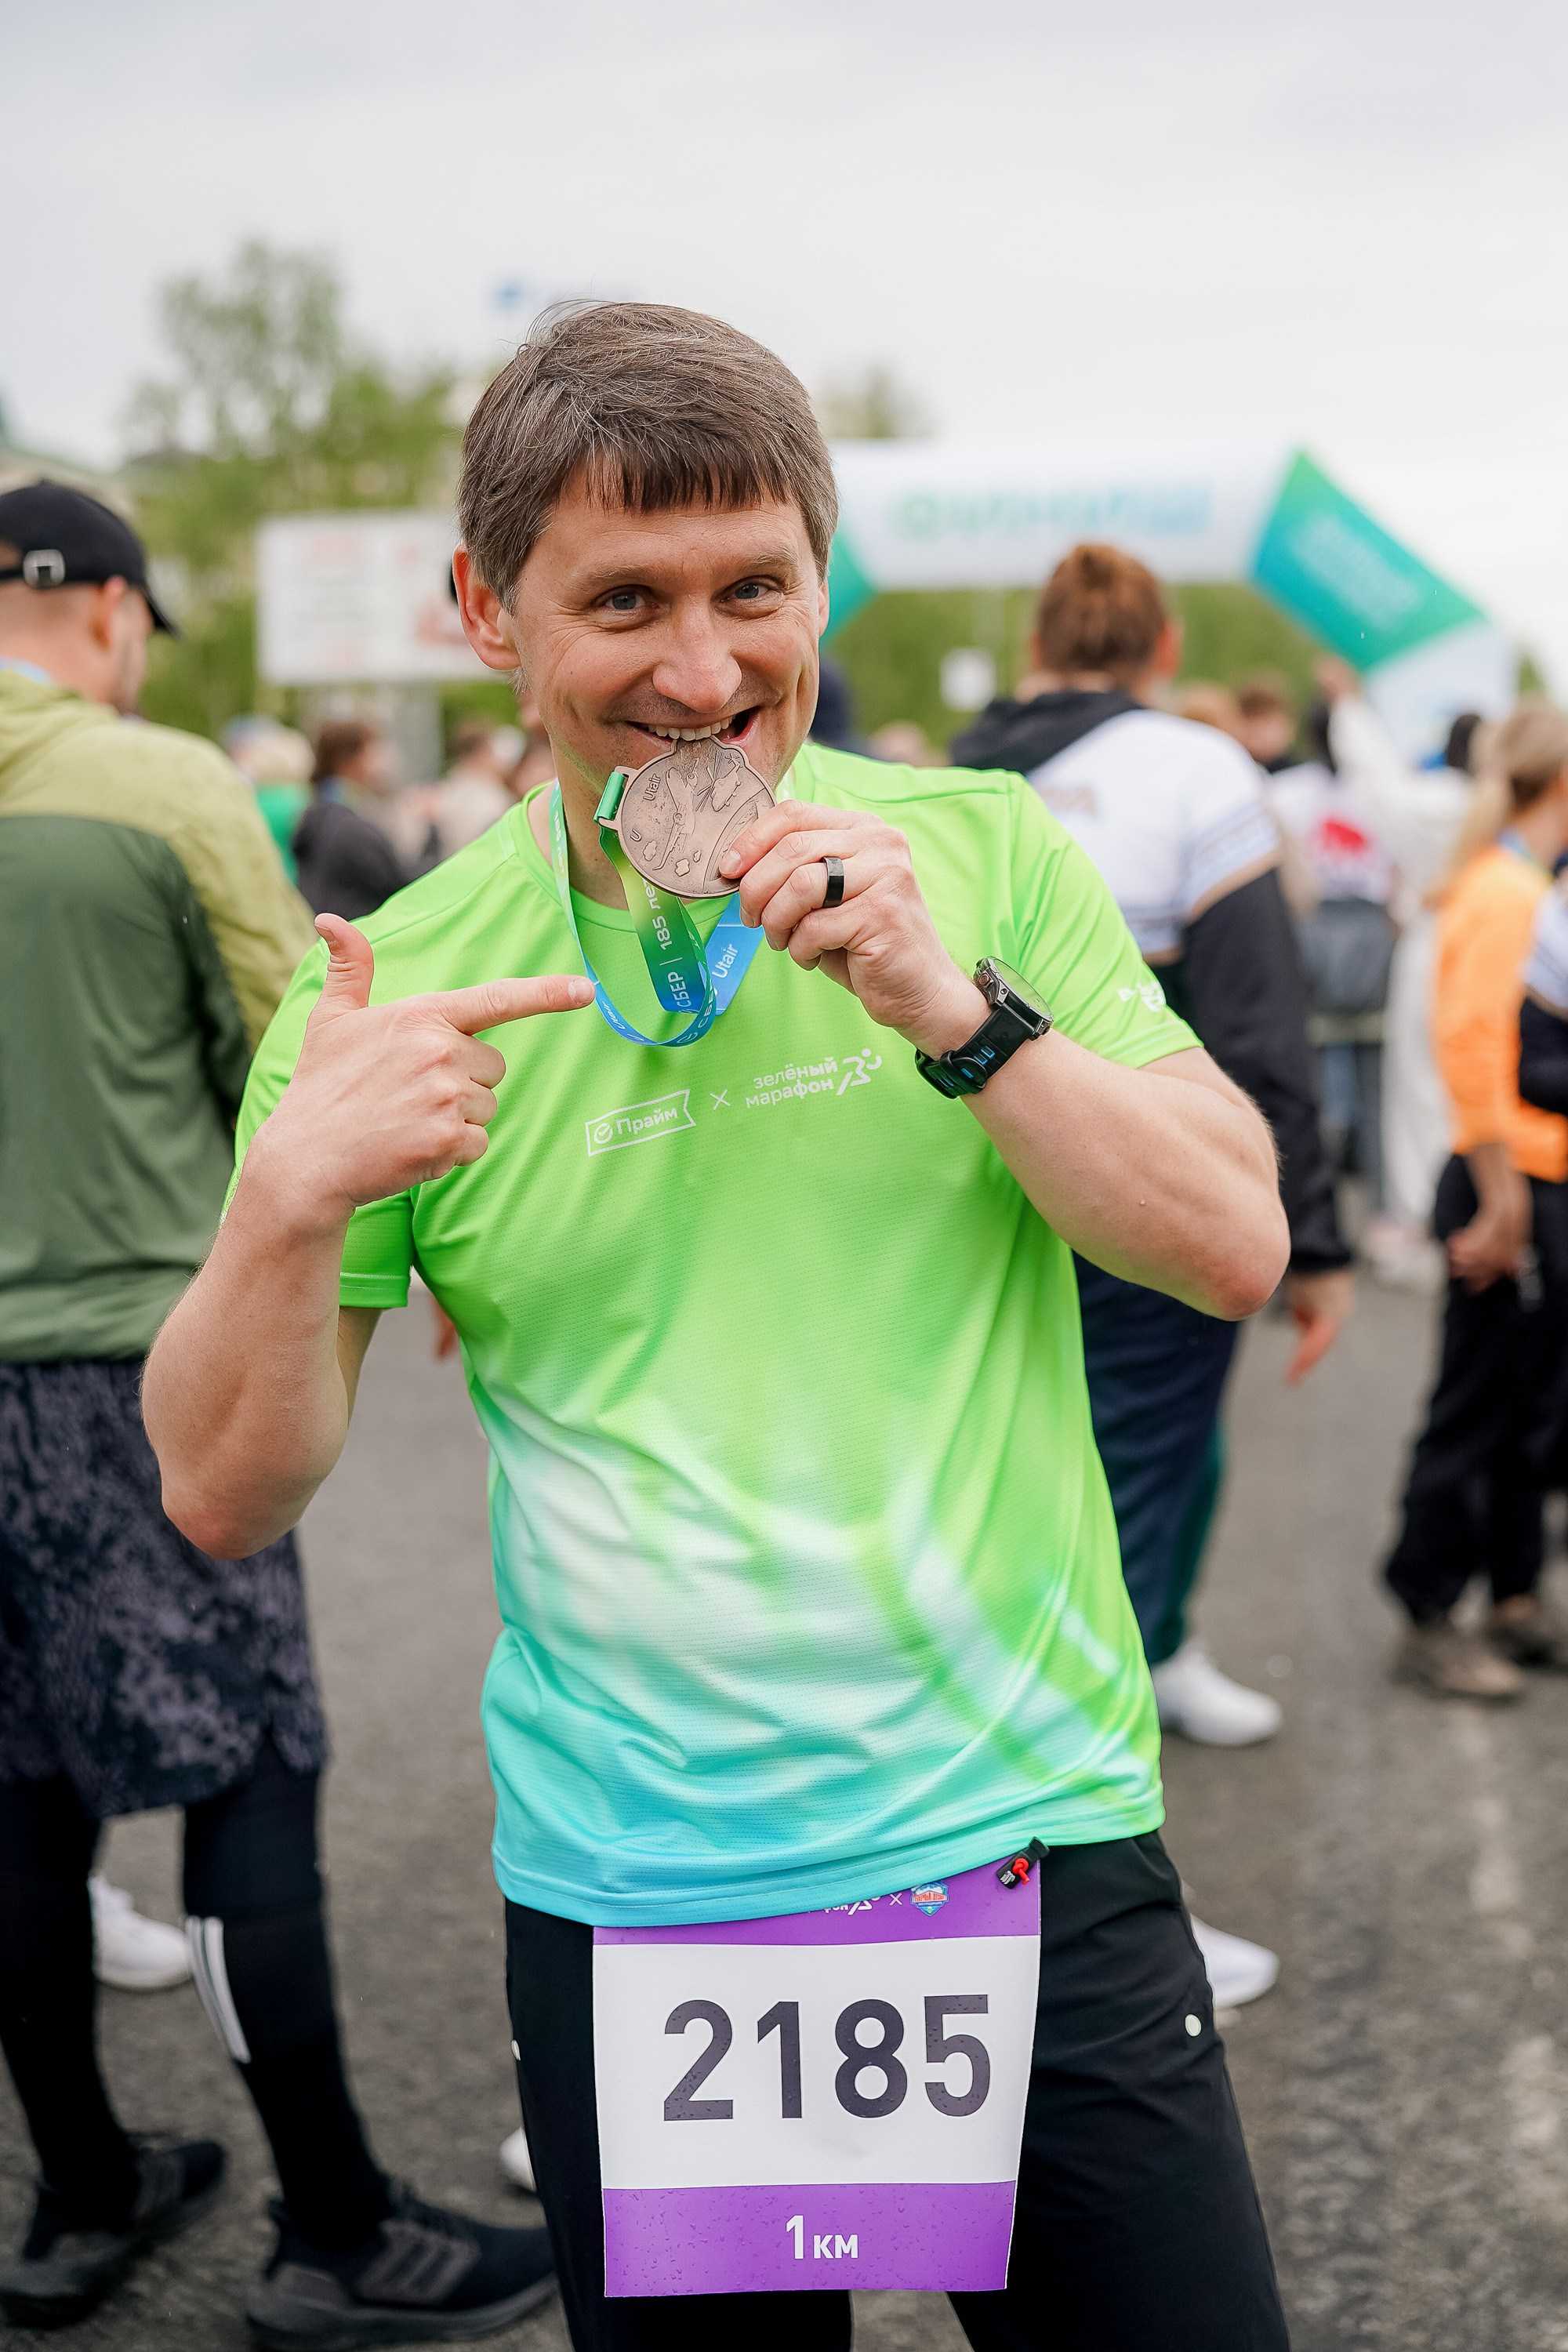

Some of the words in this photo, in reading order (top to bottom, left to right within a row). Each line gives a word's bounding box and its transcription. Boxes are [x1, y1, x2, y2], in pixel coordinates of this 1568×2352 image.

[643, 773, 661, 800] Utair
[652, 916, 673, 950] 185
[712, 943, 738, 978] Utair
[667, 971, 691, 1007] СБЕР
[753, 1057, 838, 1089] зелёный
[746, 1077, 834, 1109] марафон
[616, 1106, 678, 1134] Прайм
[663, 1994, 991, 2122] 2185
[786, 2215, 804, 2259] 1
